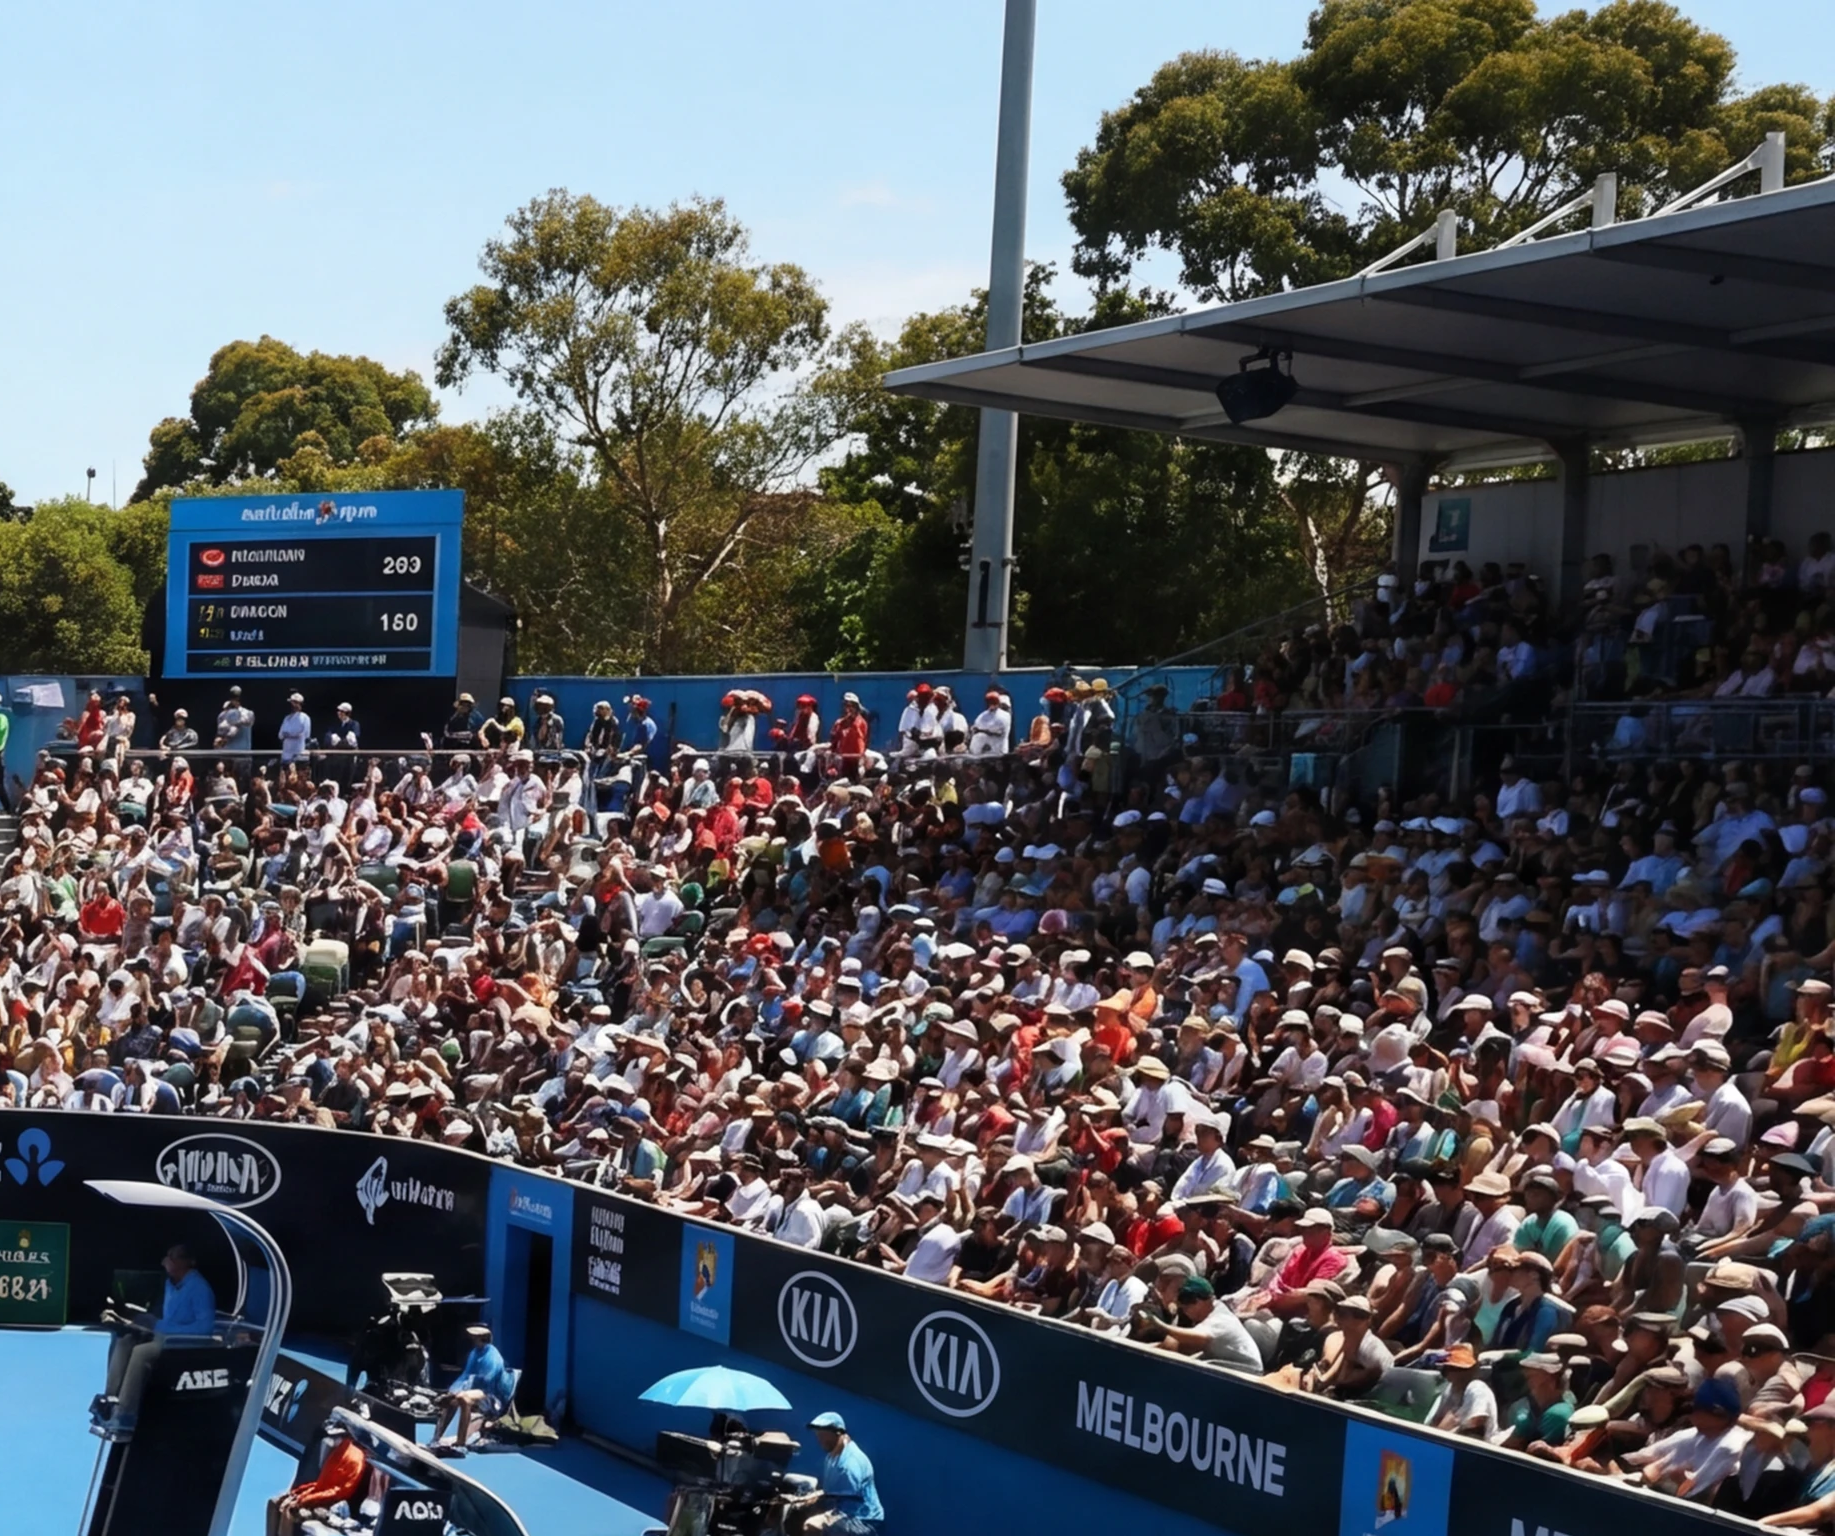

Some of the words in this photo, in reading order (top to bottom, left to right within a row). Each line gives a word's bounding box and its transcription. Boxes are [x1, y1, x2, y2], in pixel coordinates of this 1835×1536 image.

[790, 1286, 843, 1353] KIA
[923, 1326, 983, 1400] KIA
[1076, 1380, 1287, 1497] MELBOURNE
